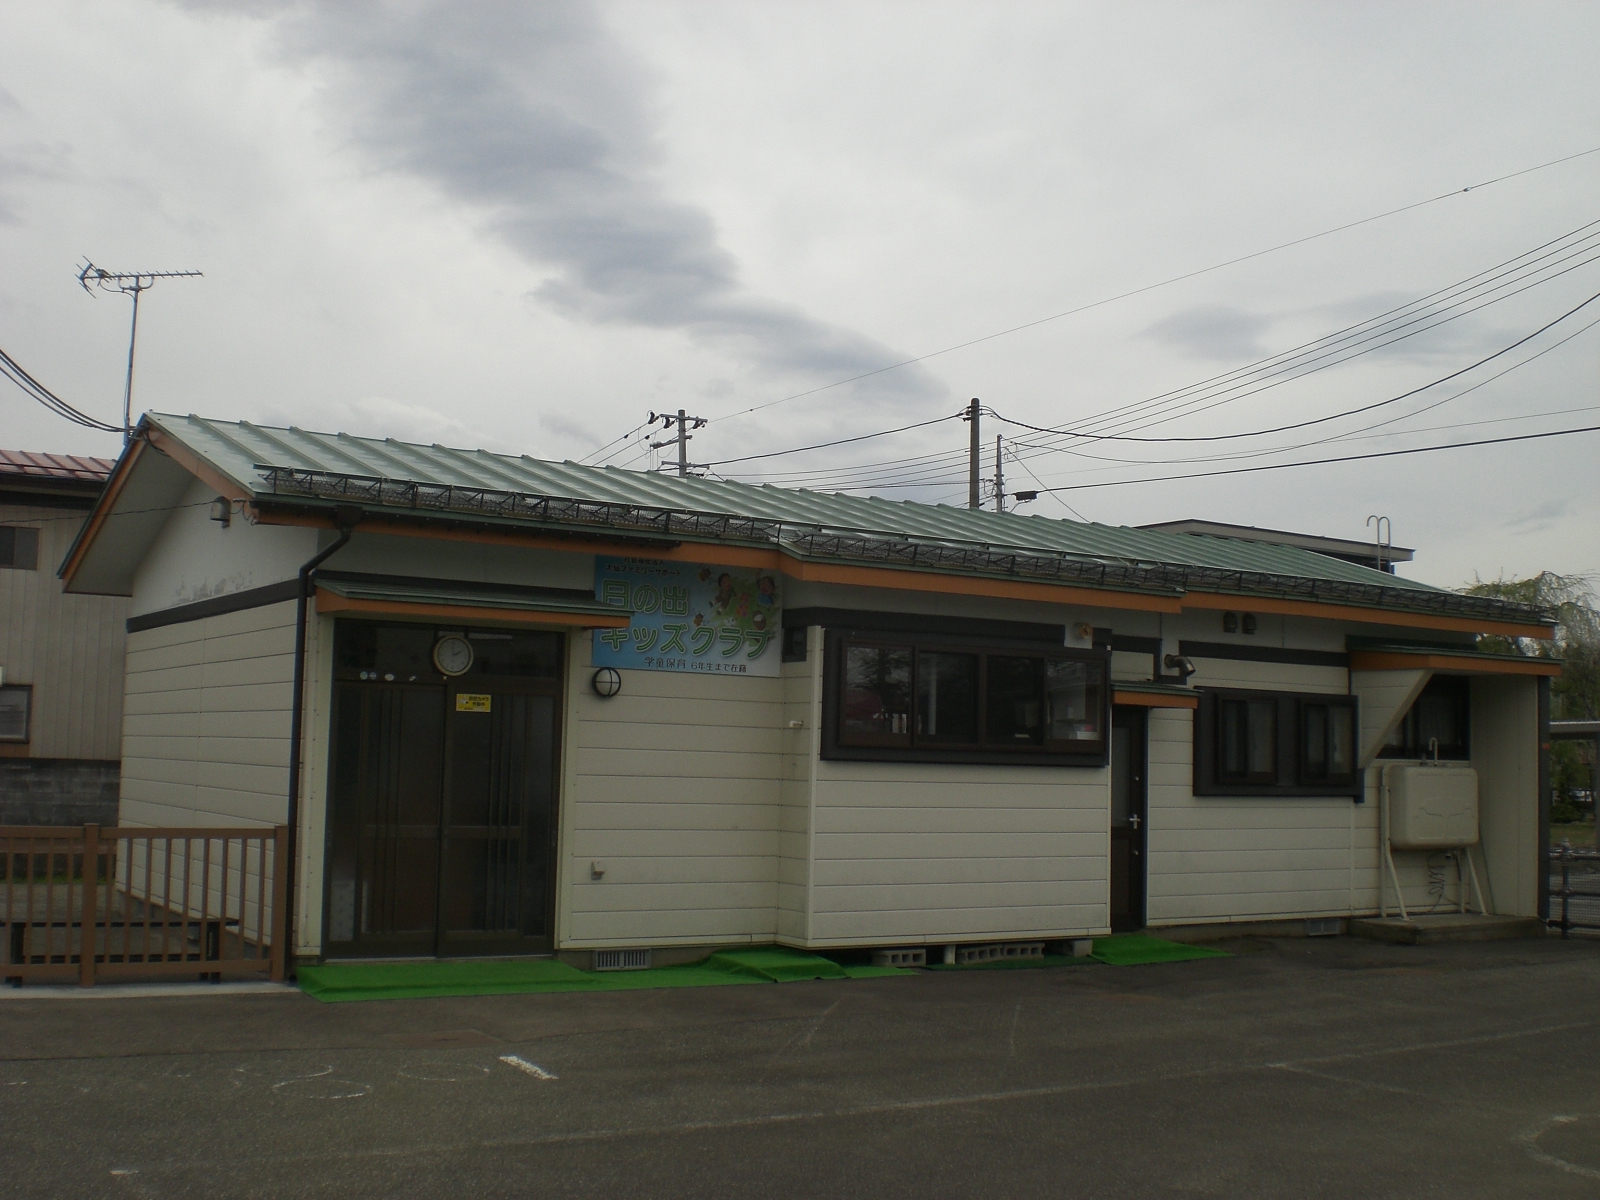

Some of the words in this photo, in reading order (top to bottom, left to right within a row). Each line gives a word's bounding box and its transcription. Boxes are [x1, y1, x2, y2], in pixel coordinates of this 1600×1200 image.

[606, 564, 681, 577] 大仙ファミリーサポート
[602, 579, 689, 616] 日の出
[600, 623, 772, 659] キッズクラブ
[644, 656, 686, 669] 学童保育
